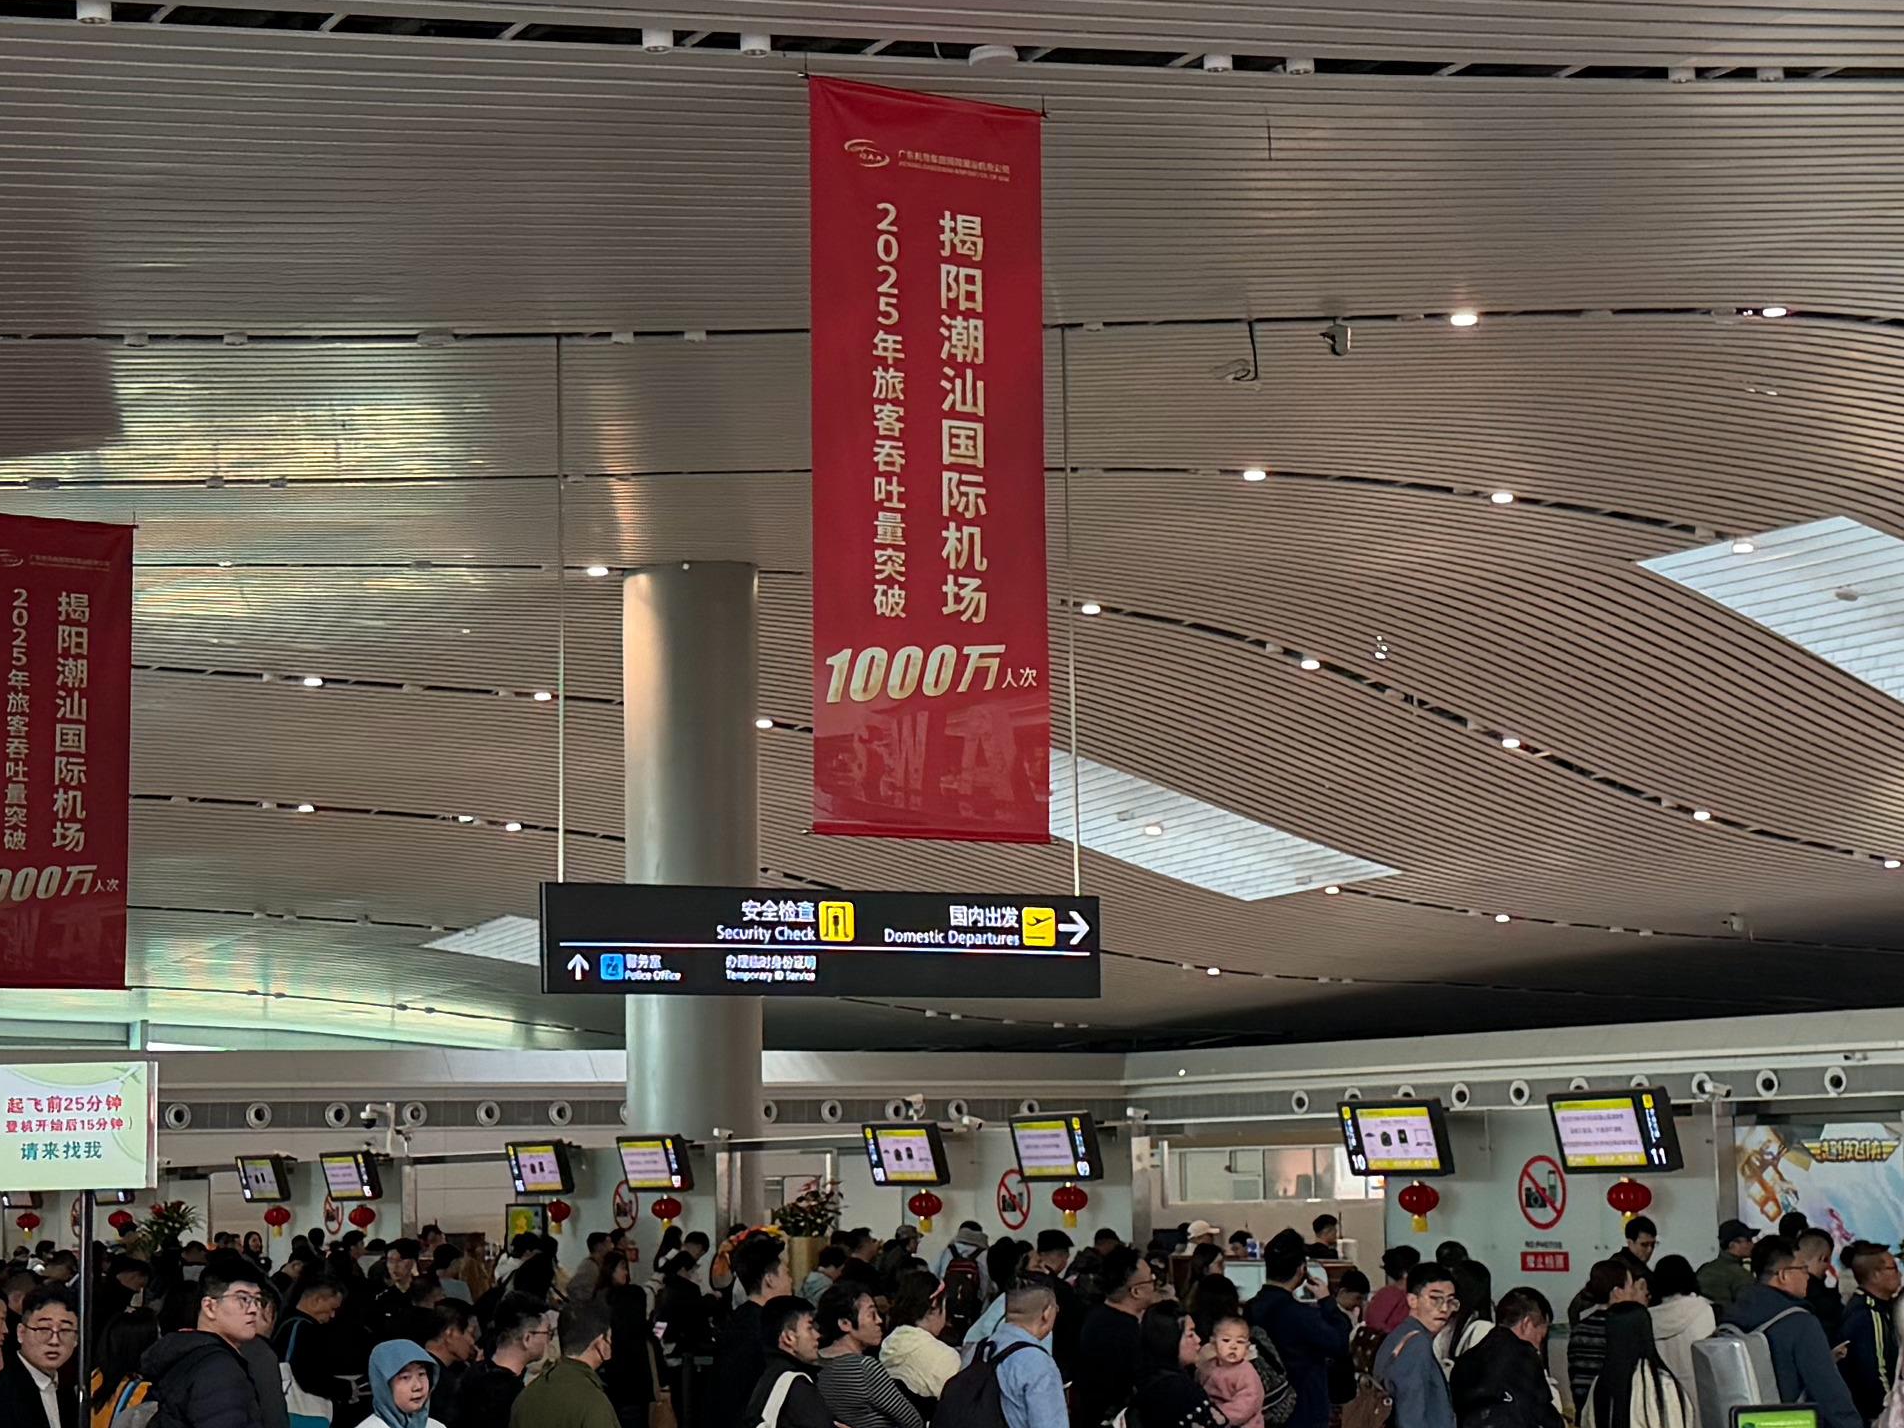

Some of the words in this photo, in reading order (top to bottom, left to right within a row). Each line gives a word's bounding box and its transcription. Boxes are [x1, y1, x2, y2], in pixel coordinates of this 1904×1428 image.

[871, 201, 907, 619] 2025年旅客吞吐量突破
[938, 210, 988, 624] 揭阳潮汕国际机场
[3, 588, 31, 851] 2025年旅客吞吐量突破
[51, 591, 91, 853] 揭阳潮汕国际机场
[740, 900, 816, 923] 安全检查
[948, 905, 1020, 929] 国内出发
[716, 925, 772, 944] Security
[774, 926, 817, 942] Check
[883, 927, 946, 944] Domestic
[947, 929, 1021, 948] Departures
[6, 1093, 123, 1115] 起飞前25分钟
[20, 1140, 103, 1162] 请来找我
[1650, 1147, 1667, 1165] 11
